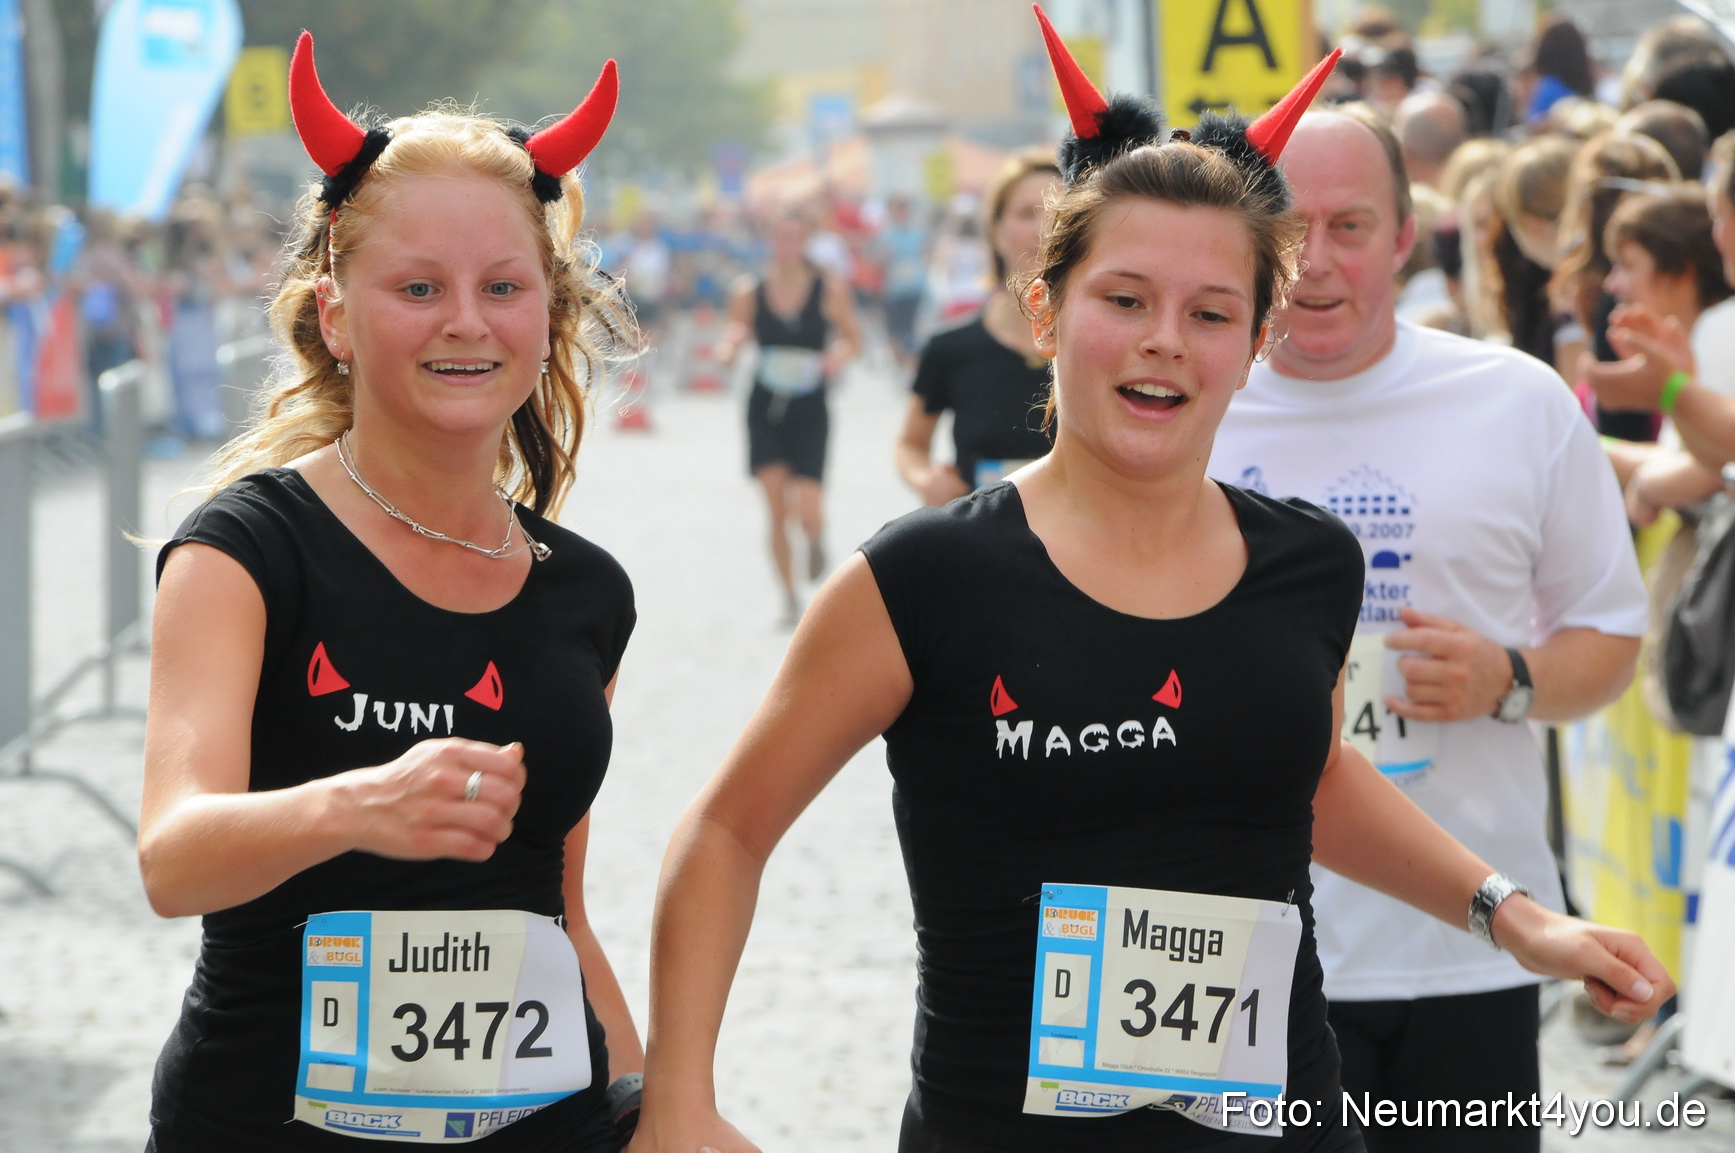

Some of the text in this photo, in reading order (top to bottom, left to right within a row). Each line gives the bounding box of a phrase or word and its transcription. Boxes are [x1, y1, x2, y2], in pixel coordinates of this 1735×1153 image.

[1202, 0, 1279, 71] A
[1343, 700, 1406, 740] 41
[389, 931, 490, 973] Judith
[1122, 908, 1224, 964] Magga
[1055, 968, 1071, 998] D
[323, 997, 339, 1027] D
[391, 1000, 553, 1063] 3472
[1120, 978, 1260, 1047] 3471
[1056, 1089, 1130, 1108] BOCK
[325, 1110, 402, 1129] BOCK
